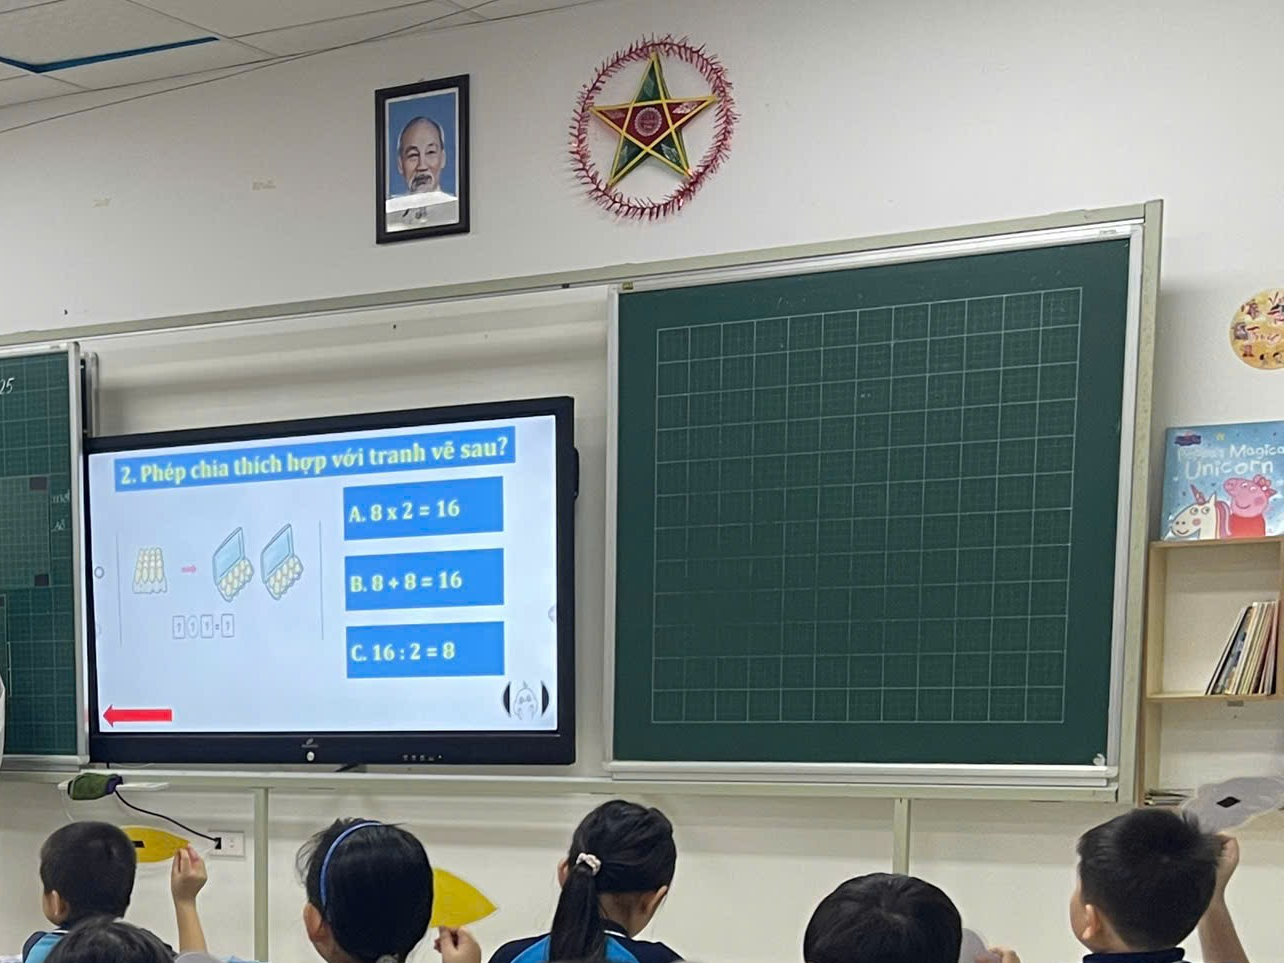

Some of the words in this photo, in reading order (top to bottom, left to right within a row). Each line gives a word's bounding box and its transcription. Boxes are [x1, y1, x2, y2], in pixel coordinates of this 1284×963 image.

[120, 466, 137, 485] 2.
[140, 462, 186, 485] Phép
[191, 459, 229, 479] chia
[234, 455, 282, 475] thích
[287, 452, 327, 475] hợp
[332, 447, 364, 468] với
[369, 443, 426, 466] tranh
[431, 441, 455, 460] vẽ
[460, 436, 508, 459] sau?
[1185, 460, 1273, 480] Unicorn
[348, 505, 366, 523] A.
[370, 504, 382, 522] 8
[386, 507, 398, 521] x
[402, 502, 413, 520] 2
[419, 505, 430, 516] =
[436, 499, 461, 518] 16
[350, 575, 367, 593] B.
[371, 574, 383, 592] 8
[388, 577, 399, 589] +
[404, 572, 416, 590] 8
[421, 576, 433, 587] =
[438, 571, 462, 589] 16
[350, 644, 367, 662] C.
[372, 643, 395, 662] 16
[409, 642, 421, 660] 2
[426, 647, 438, 658] =
[443, 641, 456, 660] 8
